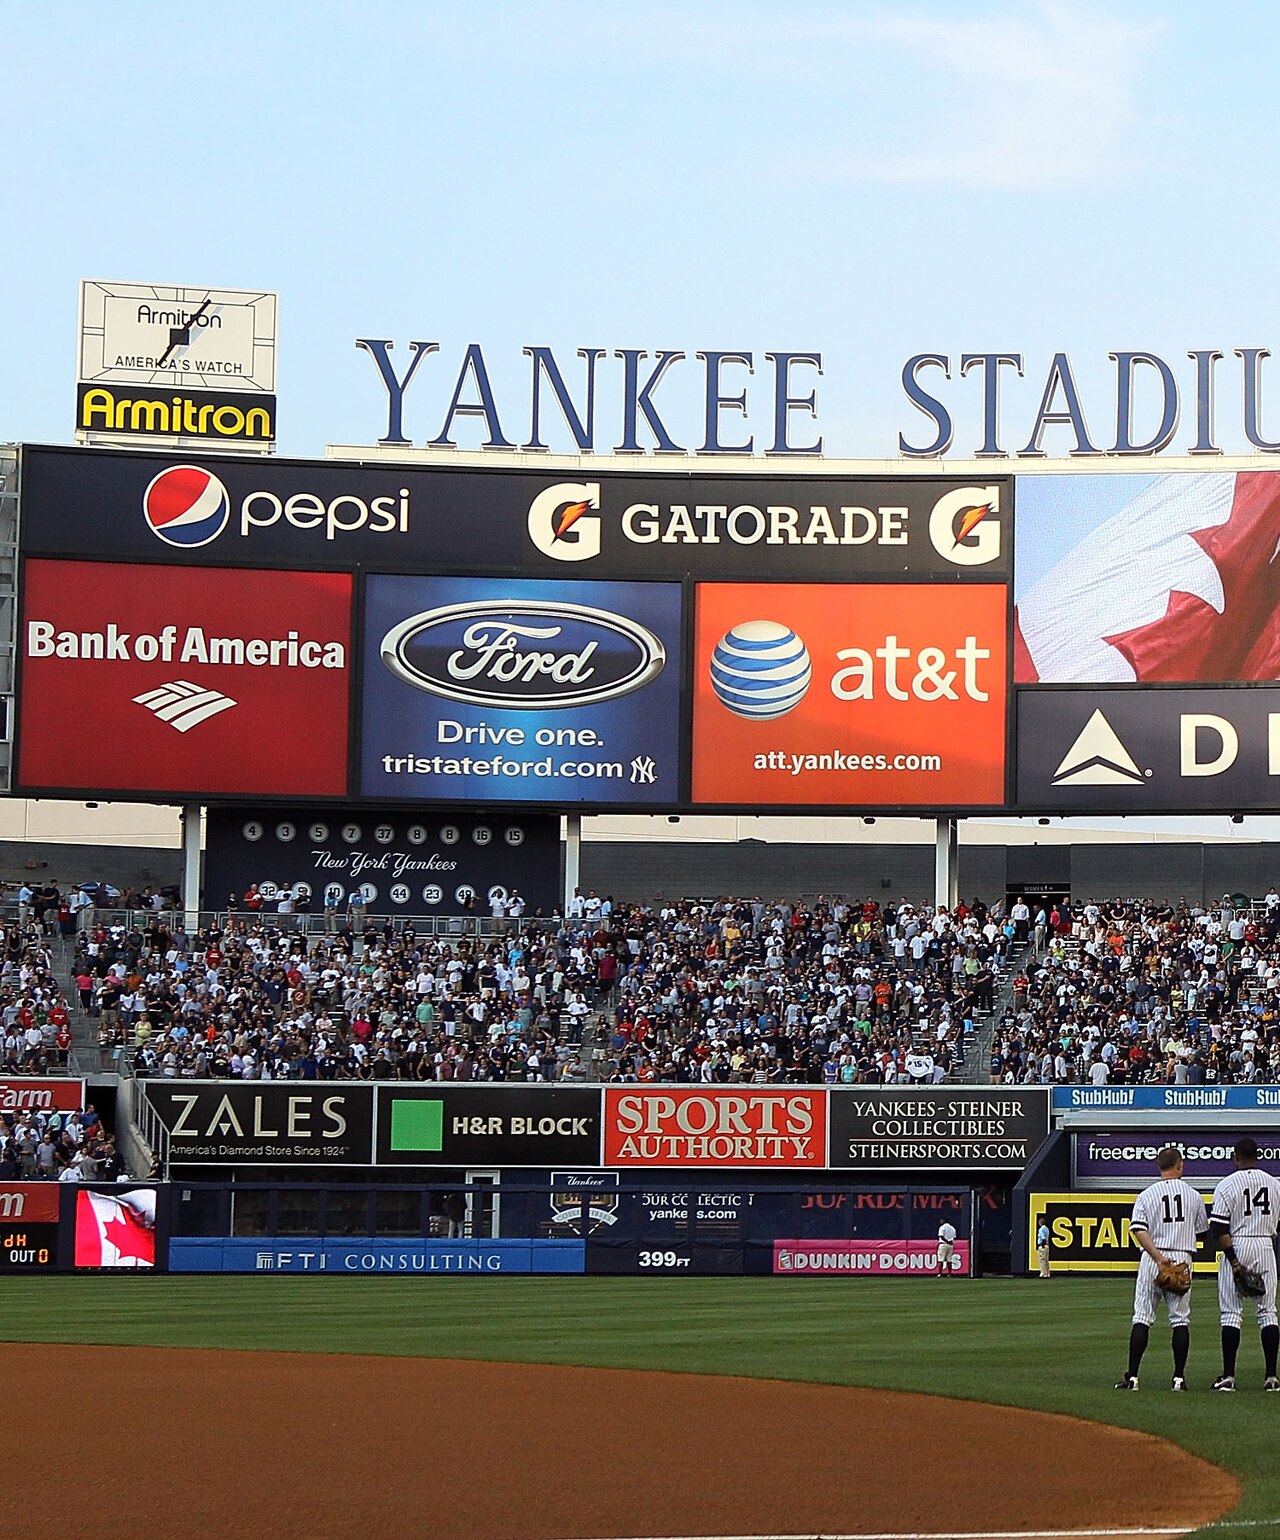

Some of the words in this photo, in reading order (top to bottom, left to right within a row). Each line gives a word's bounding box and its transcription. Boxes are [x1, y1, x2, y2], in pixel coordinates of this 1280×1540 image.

[137, 304, 222, 328] Armitron
[115, 356, 190, 370] AMERICA'S
[195, 361, 242, 374] WATCH
[356, 339, 824, 456] YANKEE
[82, 388, 272, 438] Armitron
[241, 488, 409, 540] pepsi
[621, 504, 908, 545] GATORADE
[27, 621, 133, 663] Bank
[136, 626, 176, 663] of
[181, 627, 345, 669] America
[446, 620, 597, 684] Ford
[829, 635, 990, 702] at&t
[437, 720, 526, 746] Drive
[534, 726, 604, 746] one.
[381, 754, 623, 780] tristateford.com
[753, 750, 941, 774] att.yankees.com
[311, 850, 349, 868] New
[349, 851, 391, 877] York
[392, 852, 457, 878] Yankees
[1072, 1089, 1134, 1105] StubHub!
[1165, 1089, 1226, 1106] StubHub!
[170, 1095, 347, 1138] ZALES
[453, 1117, 503, 1136] H&R
[510, 1117, 588, 1136] BLOCK
[616, 1096, 813, 1135] SPORTS
[872, 1120, 1006, 1136] COLLECTIBLES
[169, 1145, 216, 1155] America's
[219, 1145, 263, 1155] Diamond
[265, 1146, 292, 1155] Store
[293, 1146, 320, 1156] Since
[322, 1146, 345, 1156] 1924
[617, 1136, 811, 1159] AUTHORITY
[849, 1143, 1027, 1159] STEINERSPORTS.COM
[1162, 1194, 1185, 1223] 11
[1242, 1187, 1270, 1216] 14
[650, 1208, 737, 1221] yankes.com
[10, 1249, 36, 1262] OUT
[39, 1249, 48, 1263] 0
[278, 1253, 325, 1269] FTI
[345, 1254, 501, 1270] CONSULTING
[795, 1253, 877, 1269] DUNKIN'
[879, 1253, 962, 1270] DONUS
